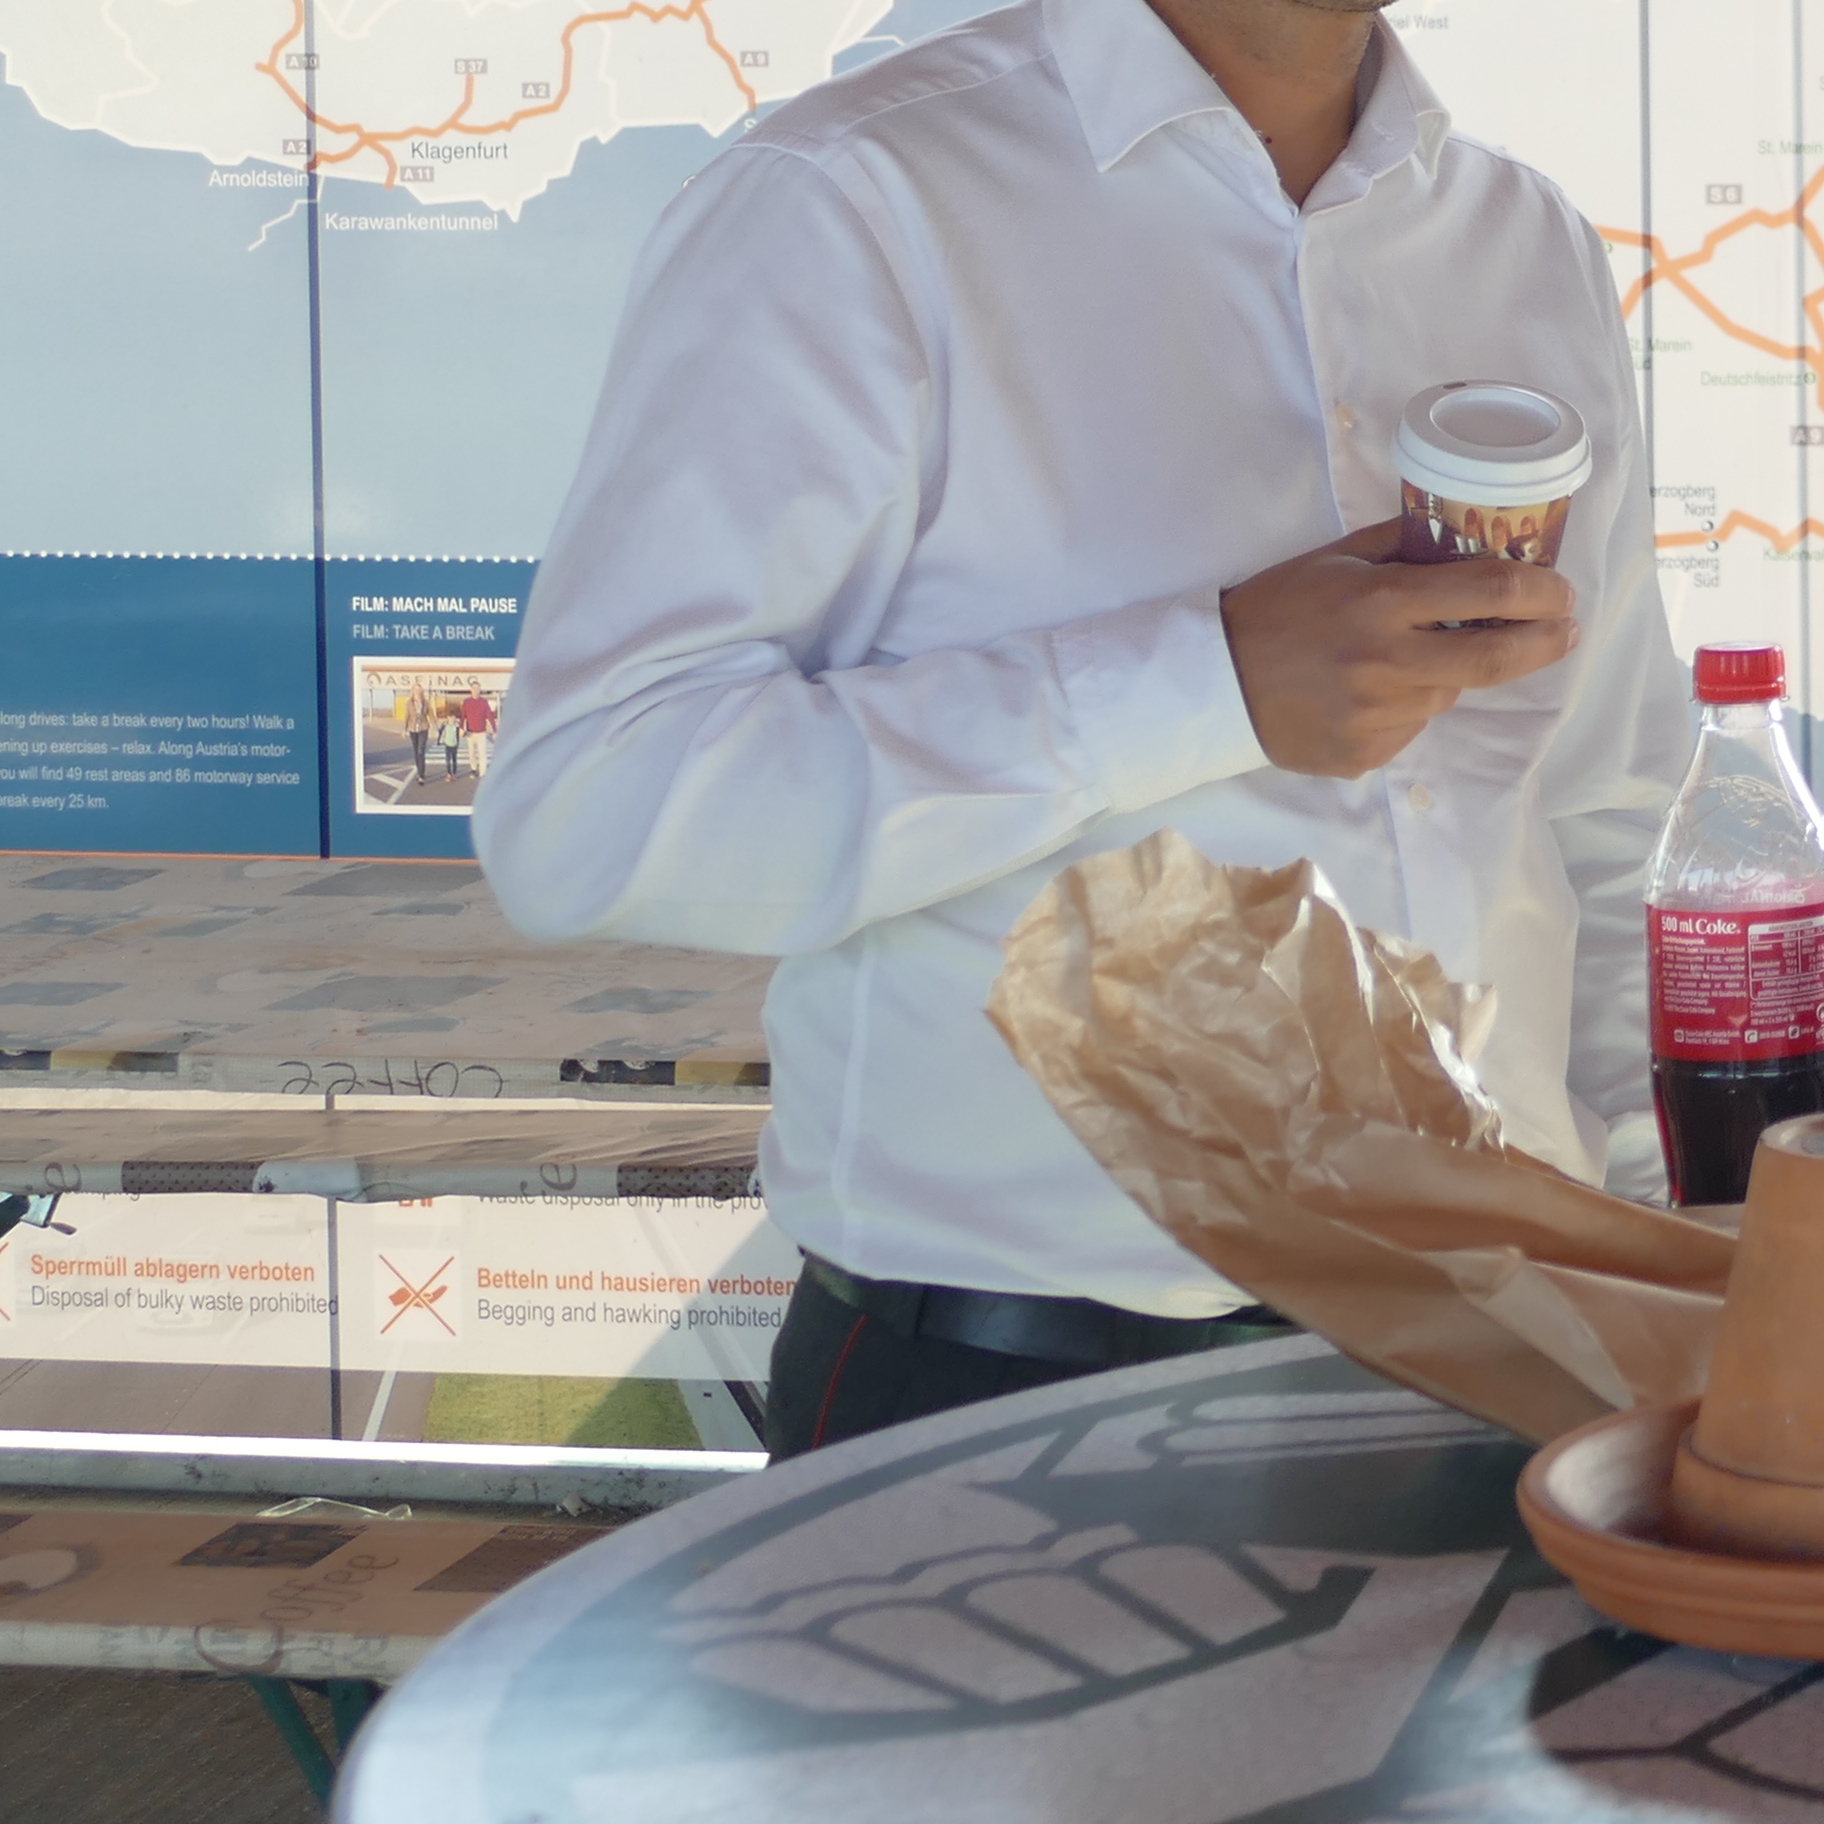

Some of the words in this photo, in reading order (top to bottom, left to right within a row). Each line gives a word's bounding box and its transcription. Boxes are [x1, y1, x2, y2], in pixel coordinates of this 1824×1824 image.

[411, 141, 508, 165] Klagenfurt
[209, 169, 309, 187] Arnoldstein
[325, 212, 499, 231] Karawankentunnel
[352, 596, 389, 612] FILM:
[392, 596, 433, 613] MACH
[437, 597, 468, 613] MAL
[470, 597, 518, 614] PAUSE
[352, 624, 389, 639] FILM:
[393, 624, 429, 640] TAKE
[432, 625, 443, 640] A
[445, 625, 496, 640] BREAK
[29, 710, 69, 729] drives:
[72, 711, 98, 729] take
[101, 716, 111, 729] a
[112, 712, 147, 729] break
[149, 716, 184, 732] every
[187, 713, 209, 730] two
[211, 712, 250, 731] hours!
[252, 714, 284, 731] Walk
[286, 717, 295, 732] a
[32, 742, 47, 756] up
[50, 741, 108, 755] exercises
[122, 739, 155, 754] relax.
[158, 740, 193, 758] Along
[196, 740, 248, 756] Austria's
[251, 743, 291, 757] motor-
[18, 766, 38, 780] will
[41, 766, 63, 781] find
[66, 766, 82, 781] 49
[85, 767, 109, 782] rest
[111, 769, 146, 783] areas
[148, 767, 171, 783] and
[174, 768, 191, 783] 86
[194, 770, 252, 787] motorway
[257, 770, 301, 785] service
[32, 795, 66, 812] every
[69, 793, 85, 809] 25
[87, 793, 110, 809] km.
[1661, 916, 1678, 933] 500
[1679, 918, 1693, 935] ml
[30, 1253, 127, 1279] Sperrmüll
[133, 1257, 220, 1284] ablagern
[226, 1259, 315, 1283] verboten
[476, 1267, 548, 1291] Betteln
[555, 1269, 593, 1293] und
[600, 1271, 701, 1295] hausieren
[707, 1273, 797, 1297] verboten
[30, 1285, 109, 1313] Disposal
[115, 1287, 132, 1308] of
[136, 1289, 183, 1316] bulky
[189, 1293, 243, 1312] waste
[249, 1292, 339, 1318] prohibited
[476, 1298, 555, 1328] Begging
[561, 1300, 597, 1323] and
[602, 1302, 682, 1330] hawking
[687, 1303, 783, 1331] prohibited
